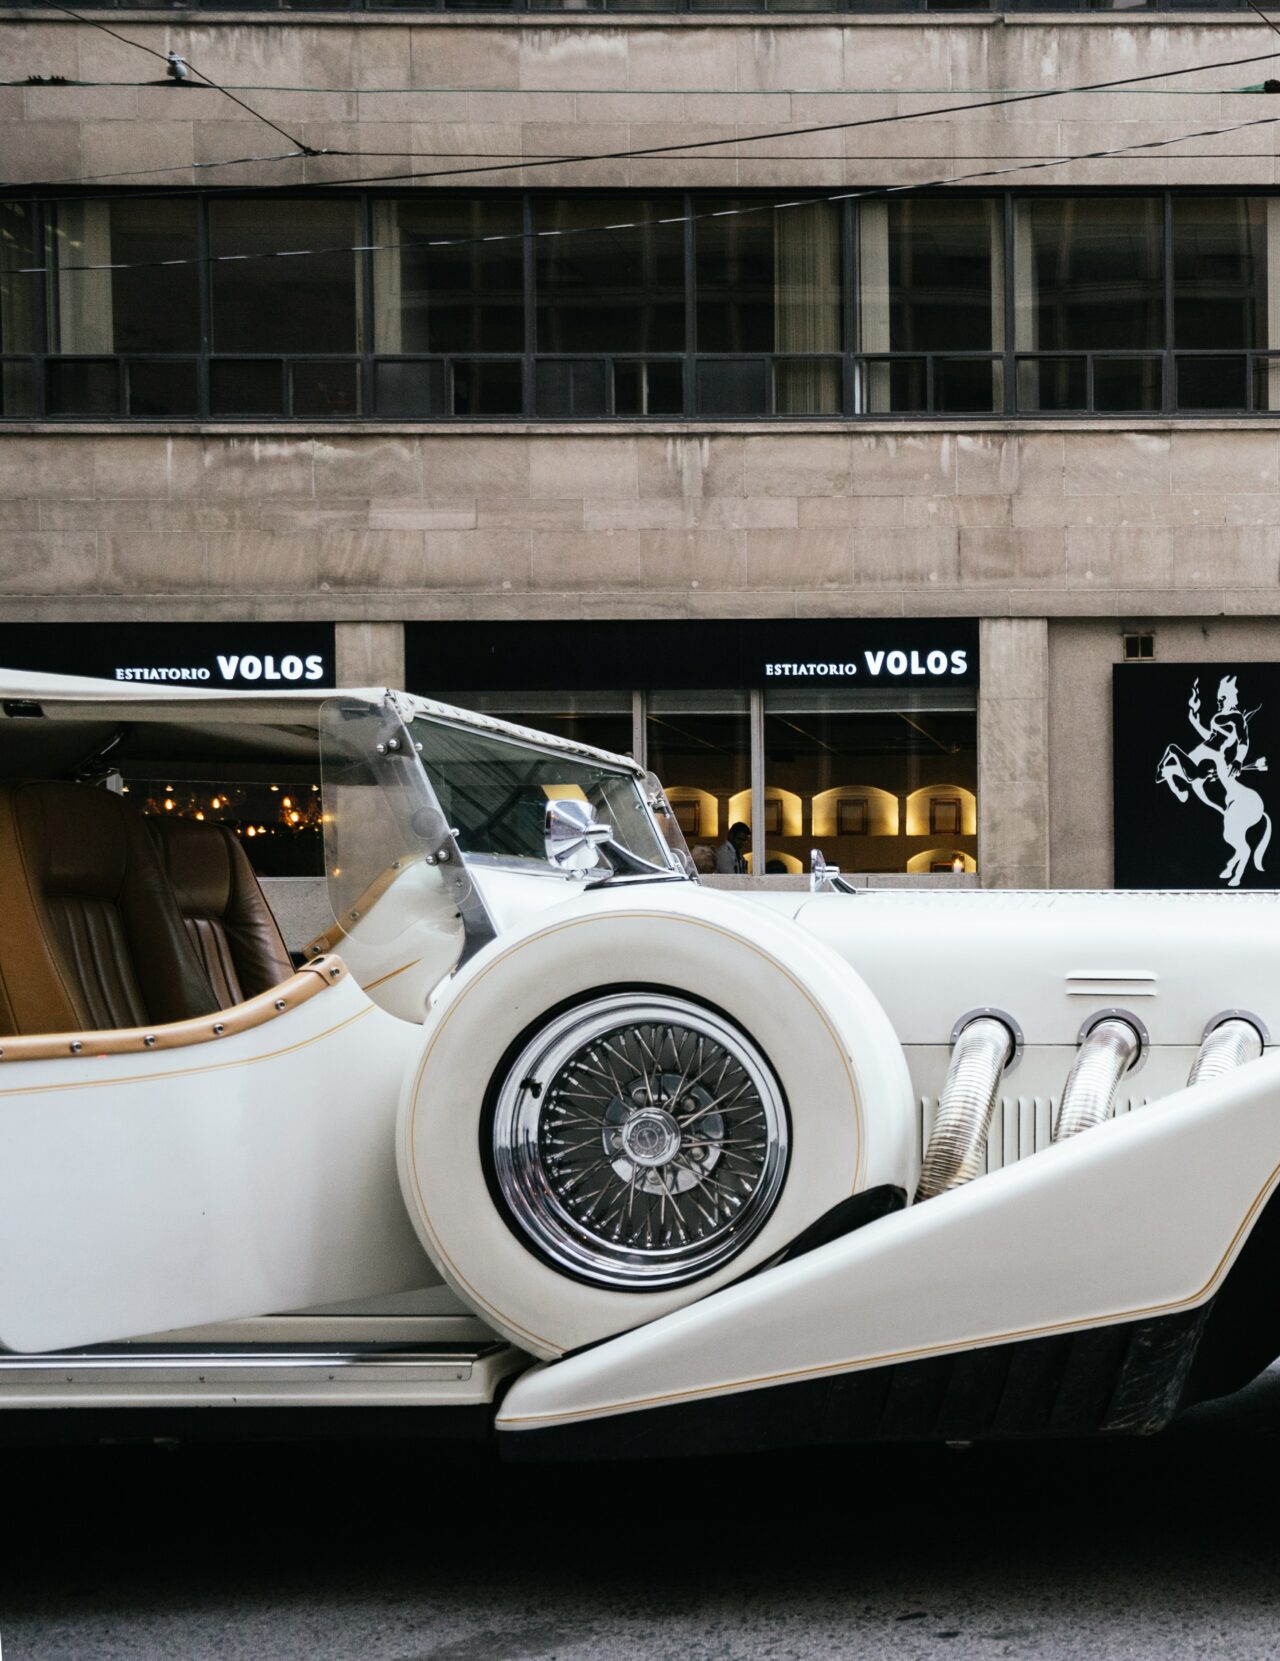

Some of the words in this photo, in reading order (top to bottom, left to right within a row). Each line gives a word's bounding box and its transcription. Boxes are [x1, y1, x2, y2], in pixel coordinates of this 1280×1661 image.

[115, 667, 211, 681] ESTIATORIO
[216, 655, 324, 681] VOLOS
[765, 663, 857, 676] ESTIATORIO
[864, 650, 968, 676] VOLOS
